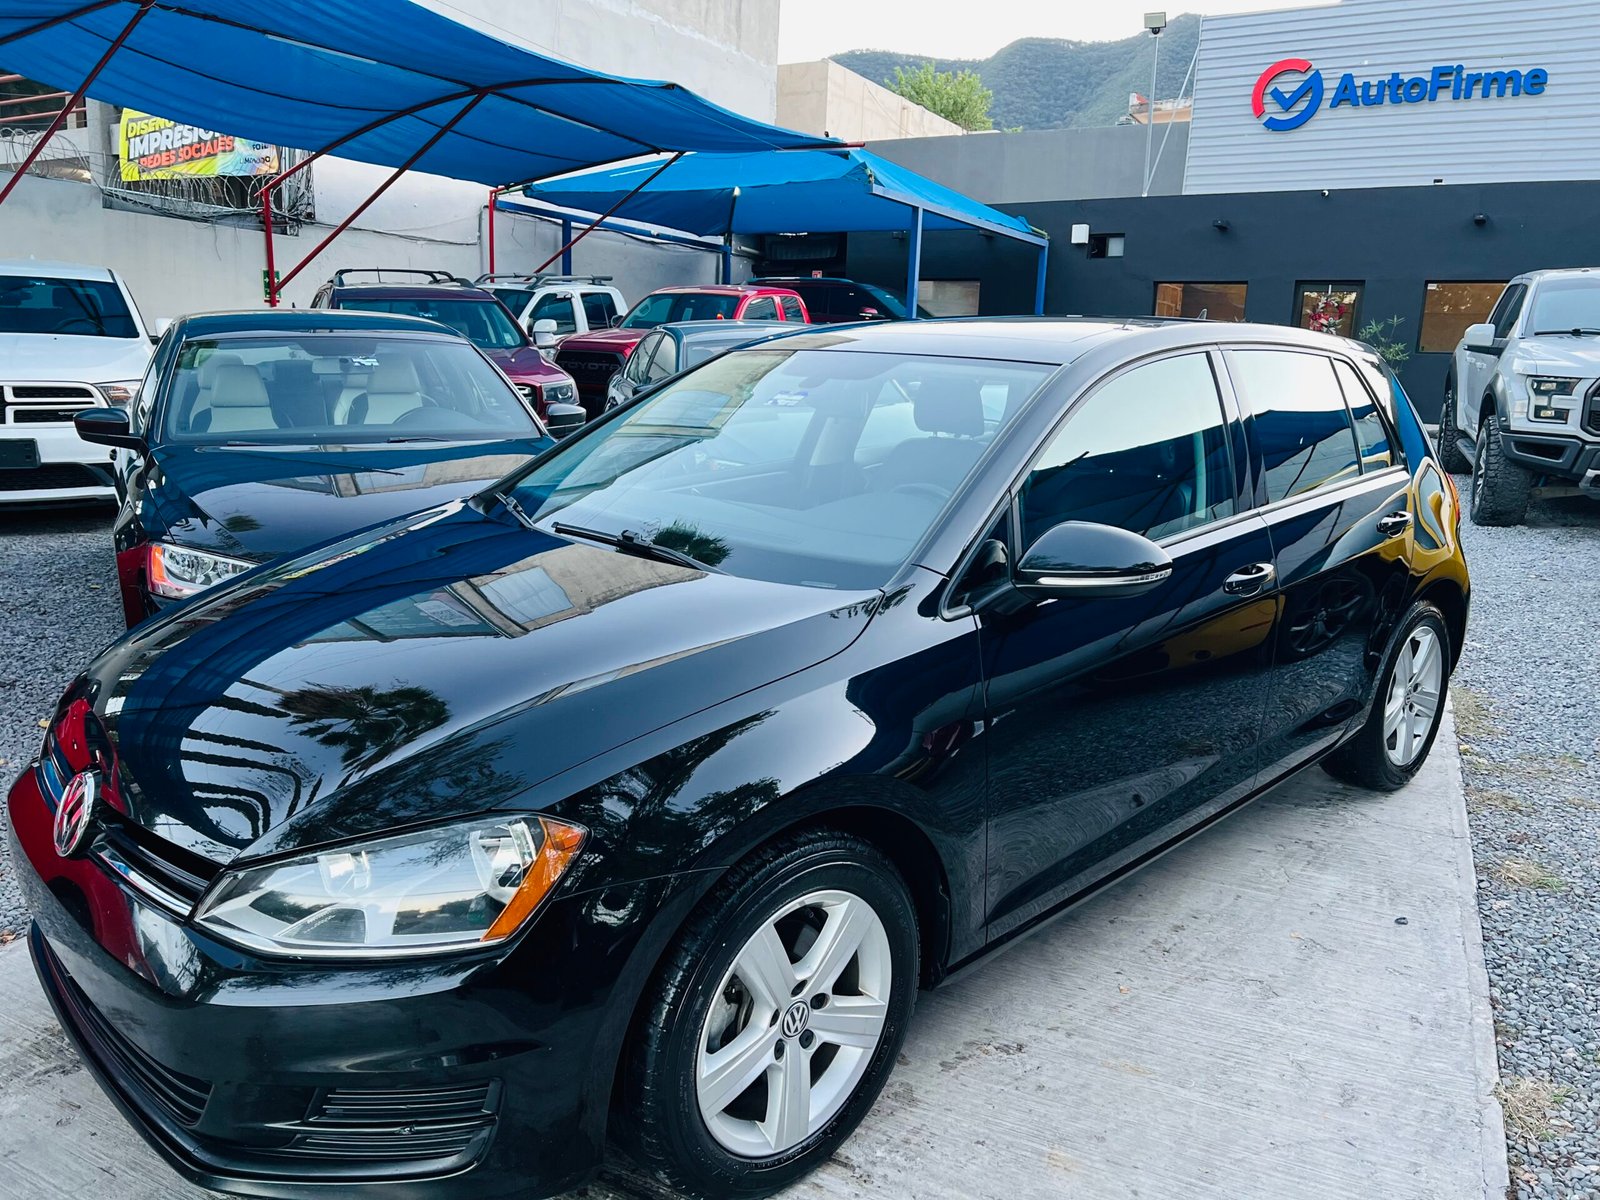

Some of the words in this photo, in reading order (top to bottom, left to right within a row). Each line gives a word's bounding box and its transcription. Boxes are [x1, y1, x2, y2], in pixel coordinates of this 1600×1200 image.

[1329, 64, 1549, 109] AutoFirme
[129, 123, 221, 160] IMPRESIO
[140, 150, 176, 168] REDES
[178, 135, 234, 162] SOCIALES
[557, 360, 620, 371] TOYOTA
[783, 1002, 809, 1037] VW
